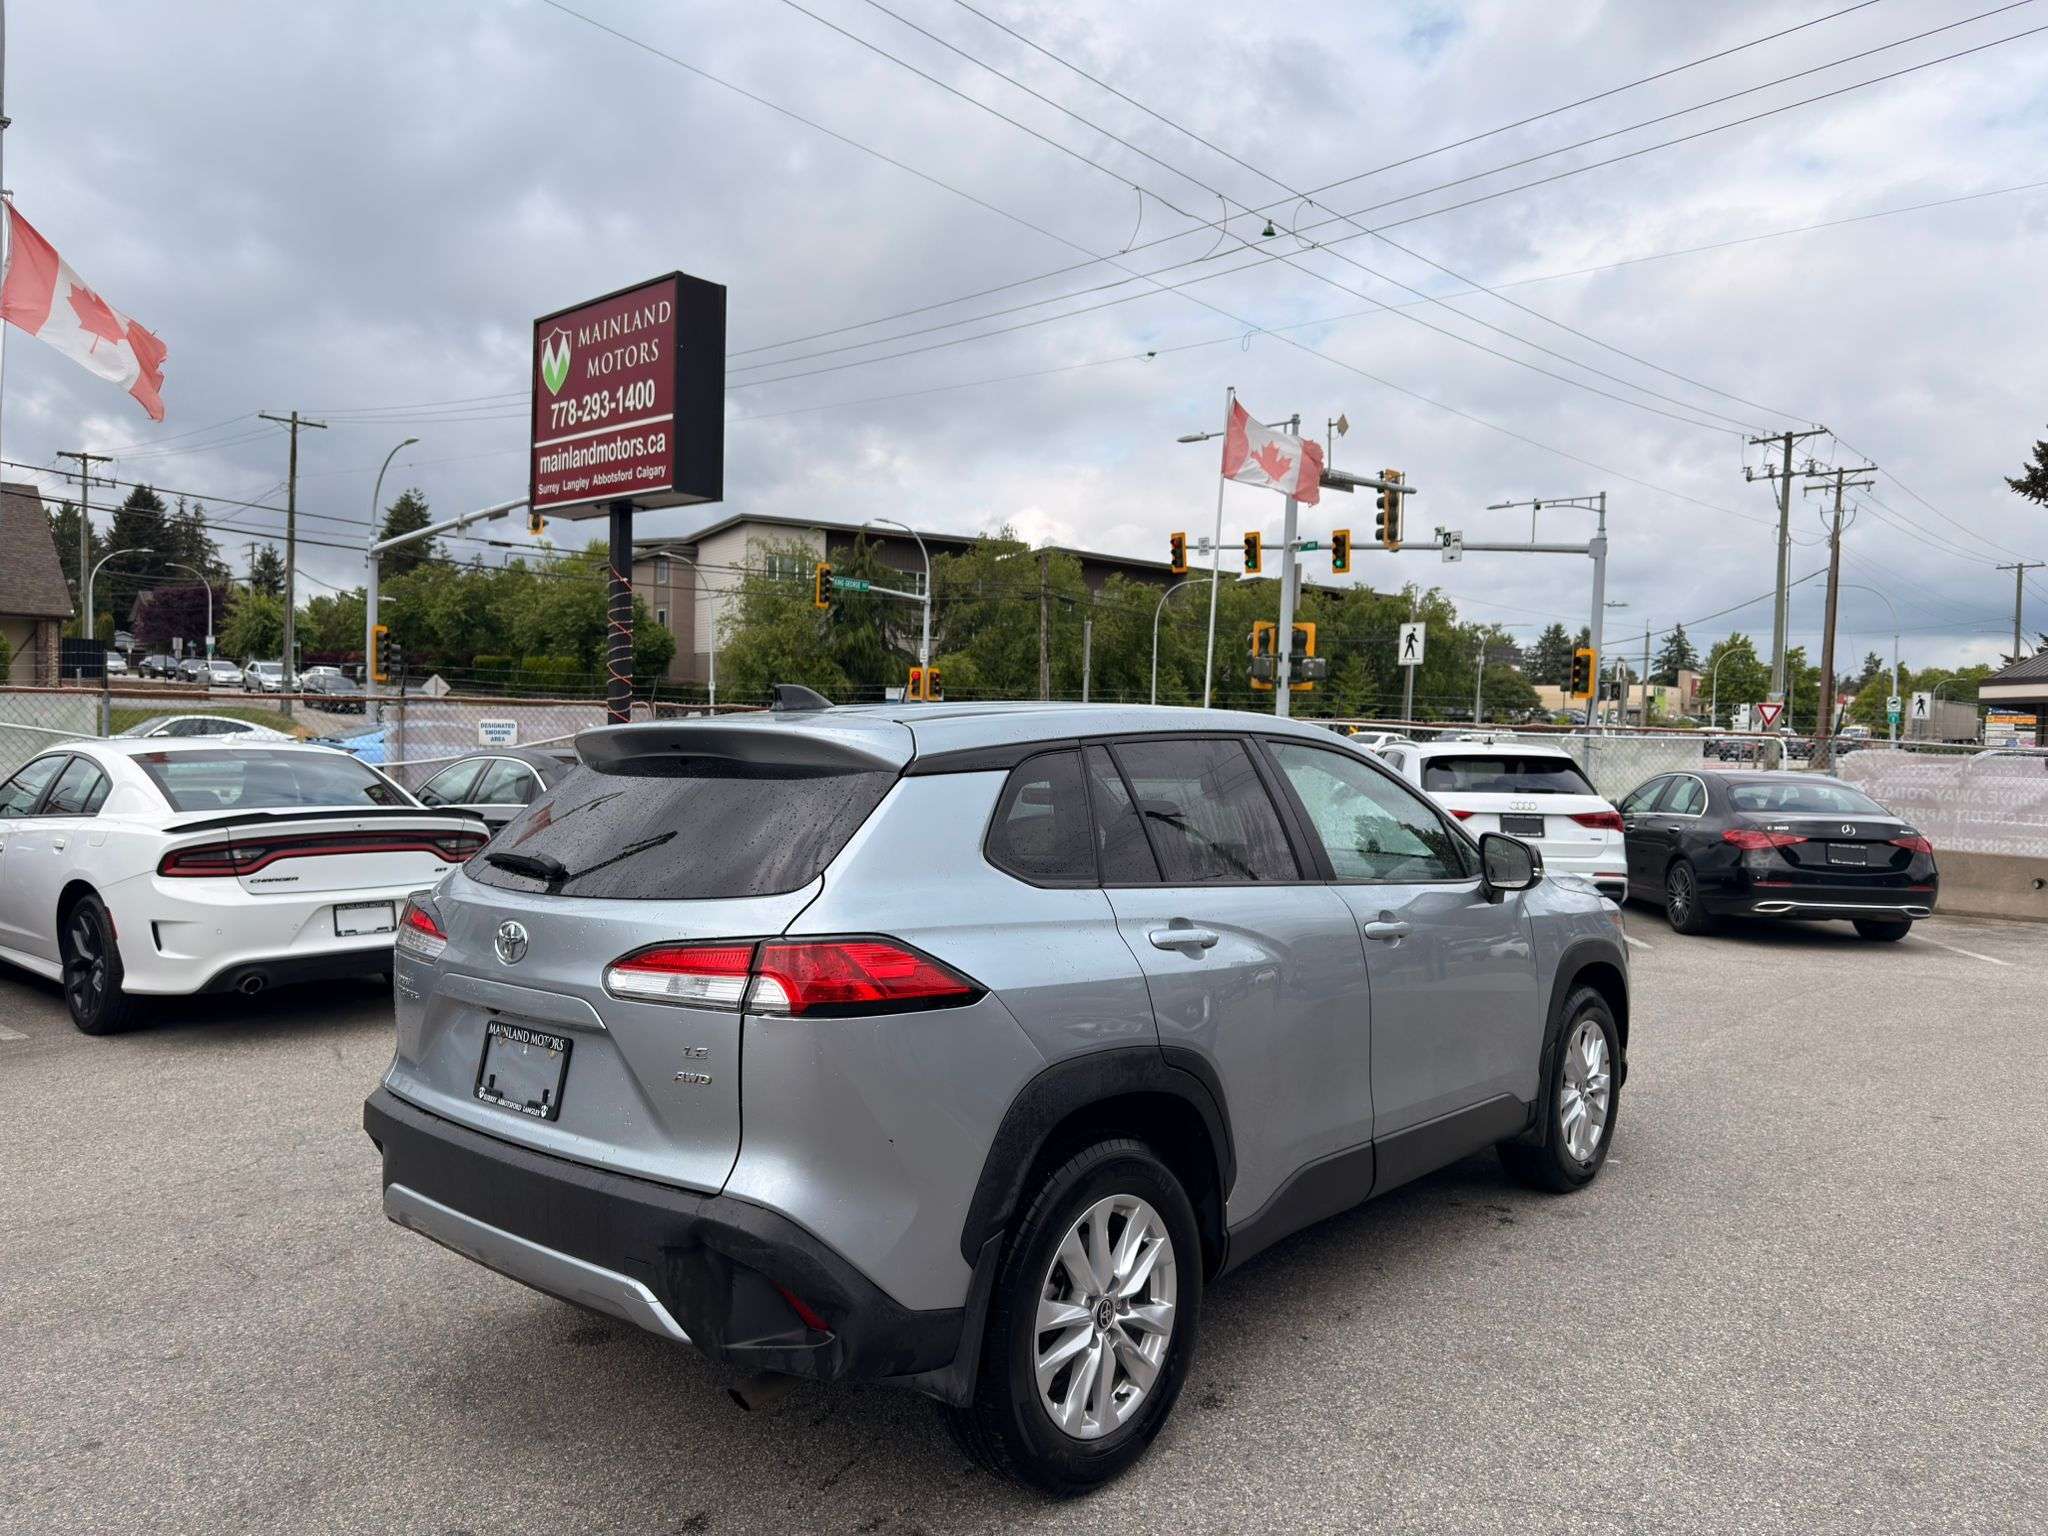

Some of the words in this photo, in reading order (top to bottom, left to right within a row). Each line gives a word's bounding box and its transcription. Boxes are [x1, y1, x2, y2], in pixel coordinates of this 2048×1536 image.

[578, 301, 671, 347] MAINLAND
[587, 338, 660, 379] MOTORS
[551, 379, 656, 430] 778-293-1400
[540, 432, 666, 474] mainlandmotors.ca
[538, 483, 560, 496] Surrey
[563, 477, 590, 492] Langley
[593, 470, 633, 486] Abbotsford
[637, 464, 666, 479] Calgary
